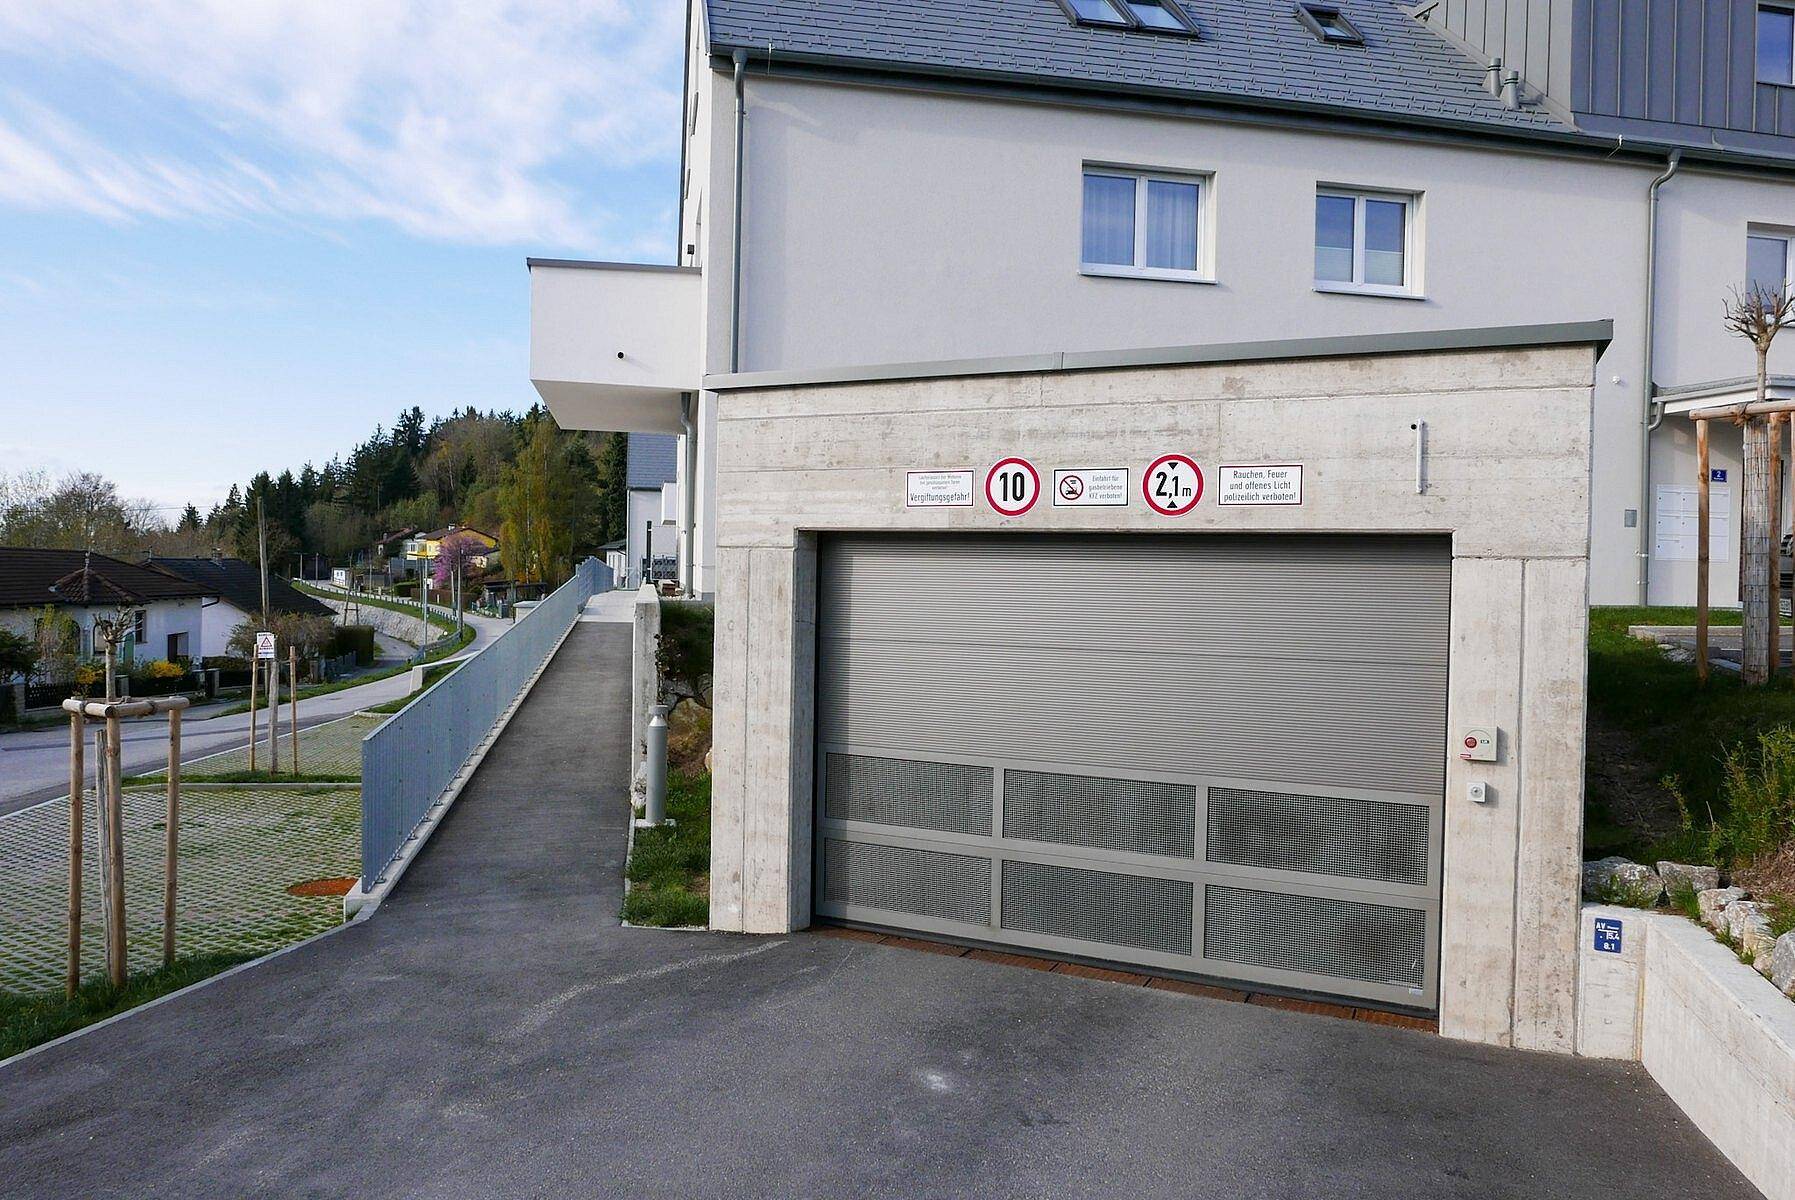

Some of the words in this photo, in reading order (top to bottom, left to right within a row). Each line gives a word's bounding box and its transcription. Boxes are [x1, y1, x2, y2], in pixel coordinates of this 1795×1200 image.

[1233, 470, 1266, 479] Rauchen,
[1267, 469, 1288, 479] Feuer
[999, 471, 1025, 501] 10
[1229, 482, 1243, 490] und
[1244, 481, 1272, 490] offenes
[1273, 480, 1291, 490] Licht
[910, 492, 970, 504] Vergiftungsgefahr!
[1223, 492, 1260, 503] polizeilich
[1261, 491, 1297, 501] verboten!
